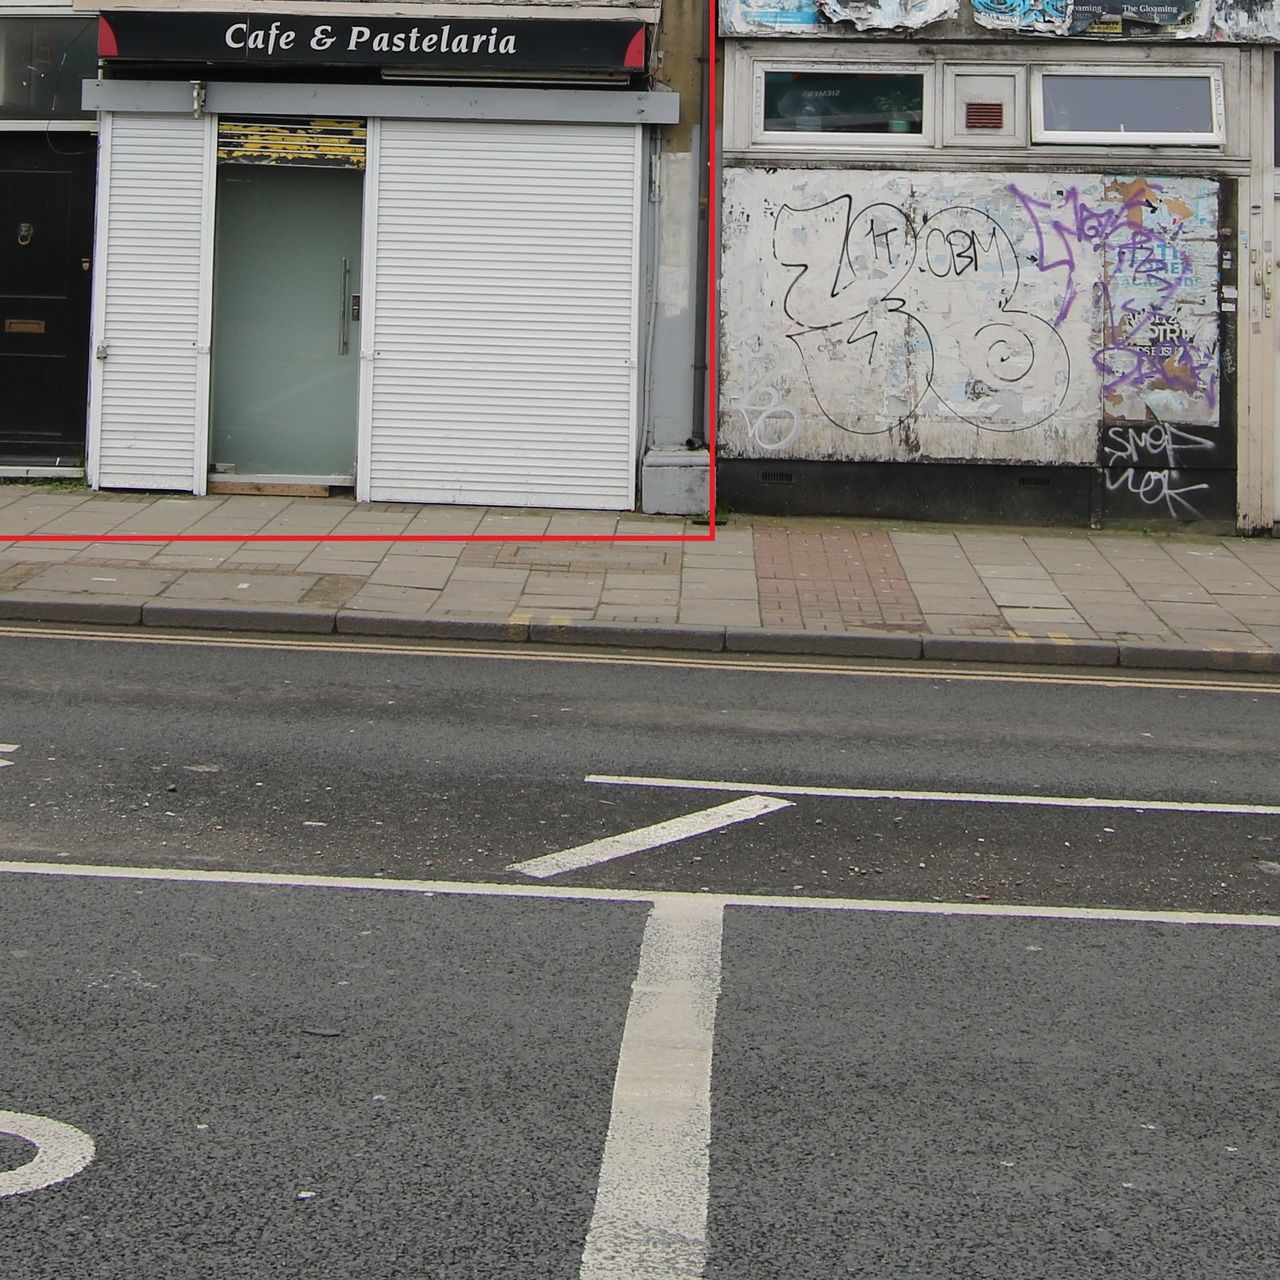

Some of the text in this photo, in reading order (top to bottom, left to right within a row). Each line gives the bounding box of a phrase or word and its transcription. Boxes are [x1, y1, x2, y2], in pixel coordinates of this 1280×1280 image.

[1139, 5, 1178, 16] Gloaming
[225, 21, 517, 55] Cafe & Pastelaria
